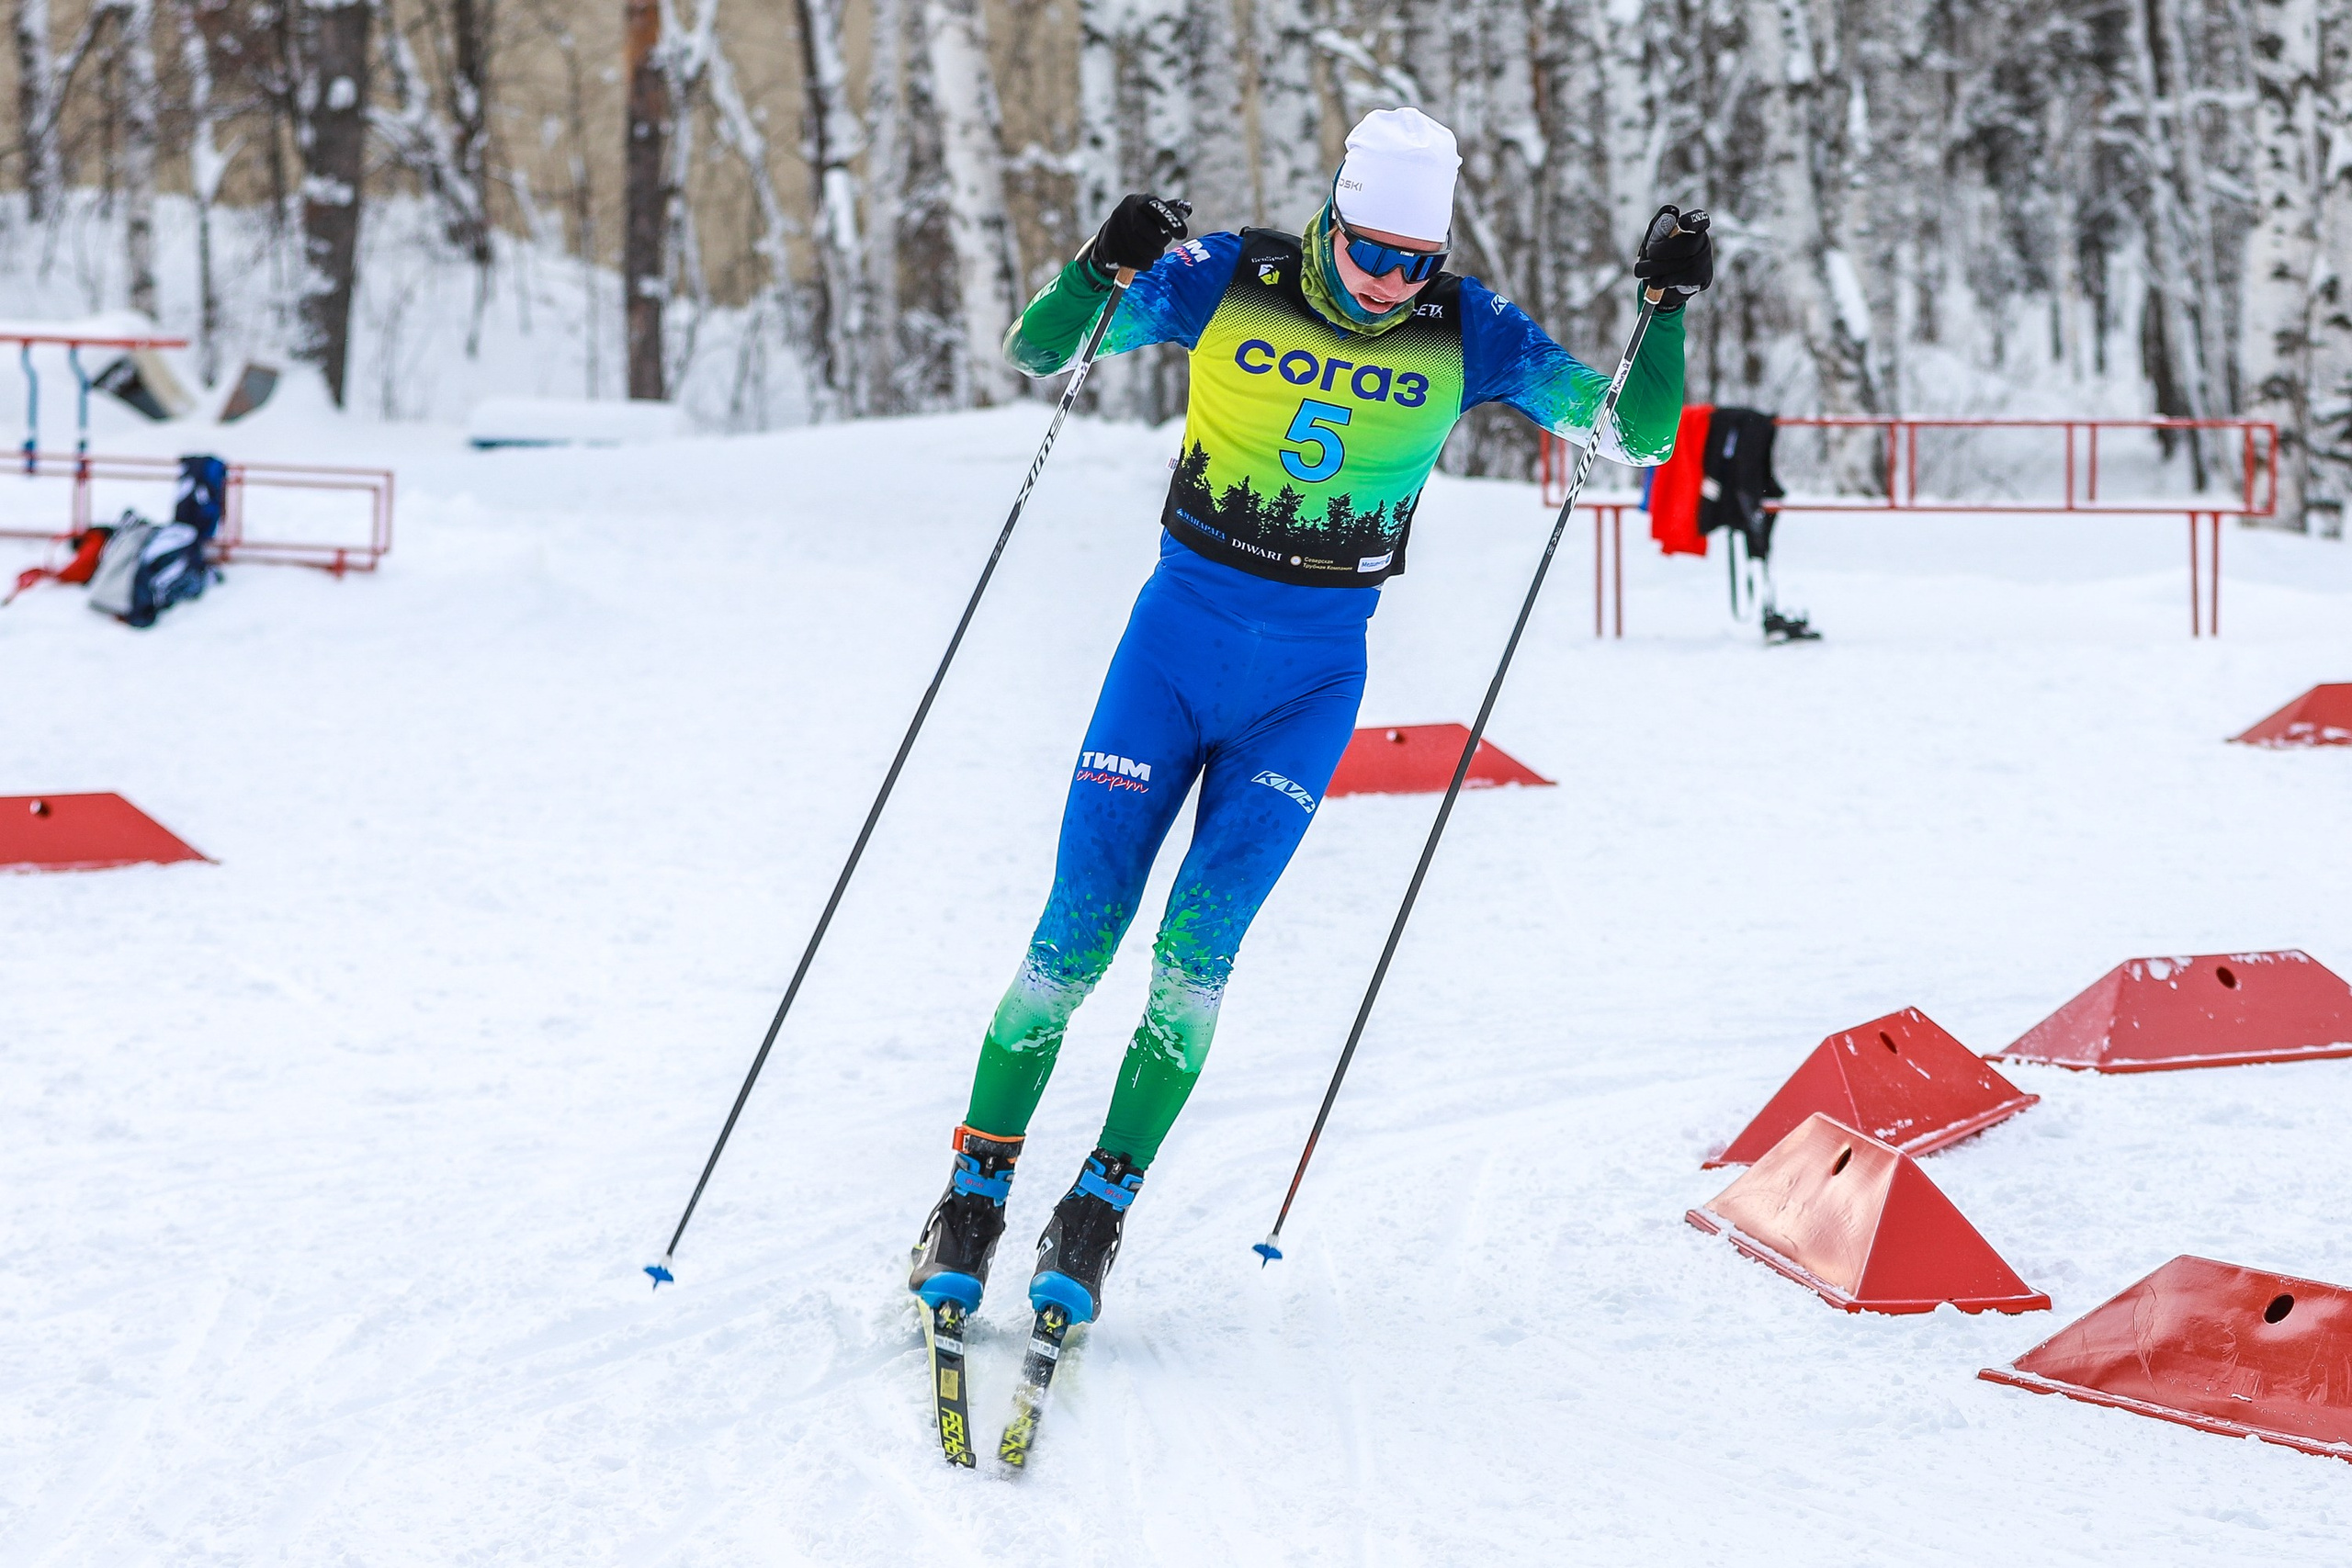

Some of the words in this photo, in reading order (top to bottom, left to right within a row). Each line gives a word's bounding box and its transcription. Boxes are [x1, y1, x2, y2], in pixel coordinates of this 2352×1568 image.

[1015, 402, 1068, 513] SWIX
[1279, 397, 1353, 484] 5
[1566, 402, 1611, 510] SWIX
[1231, 538, 1283, 561] DIWARI
[1081, 751, 1151, 782] ТИМ
